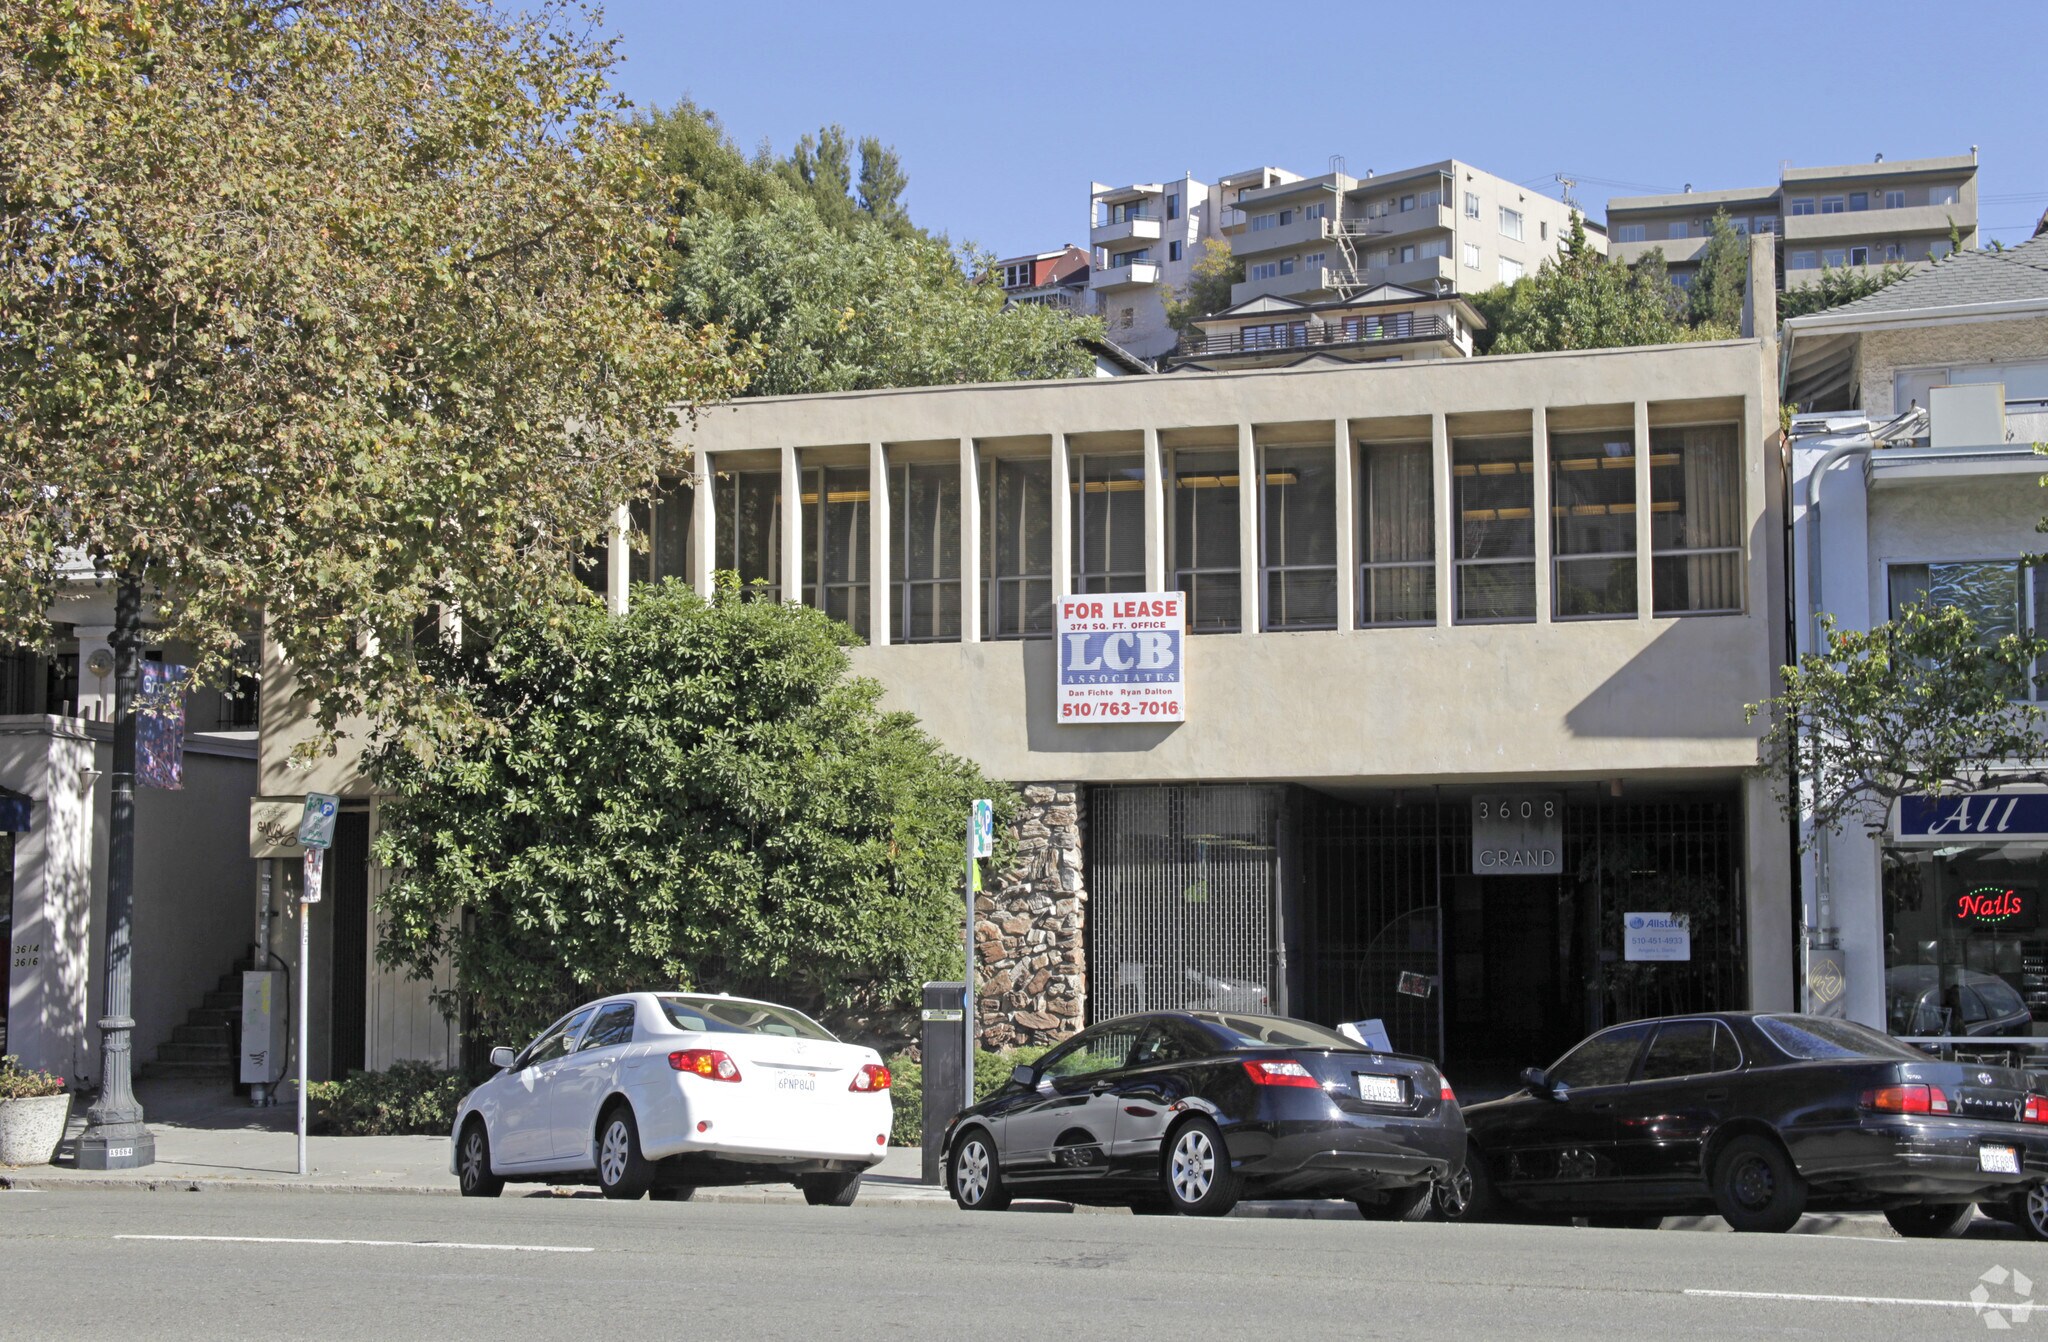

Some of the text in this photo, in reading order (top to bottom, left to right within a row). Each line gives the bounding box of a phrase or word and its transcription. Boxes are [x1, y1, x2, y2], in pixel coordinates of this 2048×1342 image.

[1064, 601, 1177, 619] FOR LEASE
[1131, 621, 1166, 629] OFFICE
[1067, 632, 1174, 670] LCB
[1067, 673, 1175, 683] ASSOCIATES
[1121, 688, 1141, 697] Ryan
[1063, 701, 1178, 717] 510/763-7016
[1480, 801, 1554, 818] 3608
[1927, 796, 2019, 835] All
[1480, 850, 1555, 867] GRAND
[1958, 890, 2021, 918] Nails
[15, 944, 39, 954] 3614
[14, 957, 38, 967] 3616
[778, 1078, 814, 1091] 6PNP840
[1965, 1097, 2012, 1108] CAMRY
